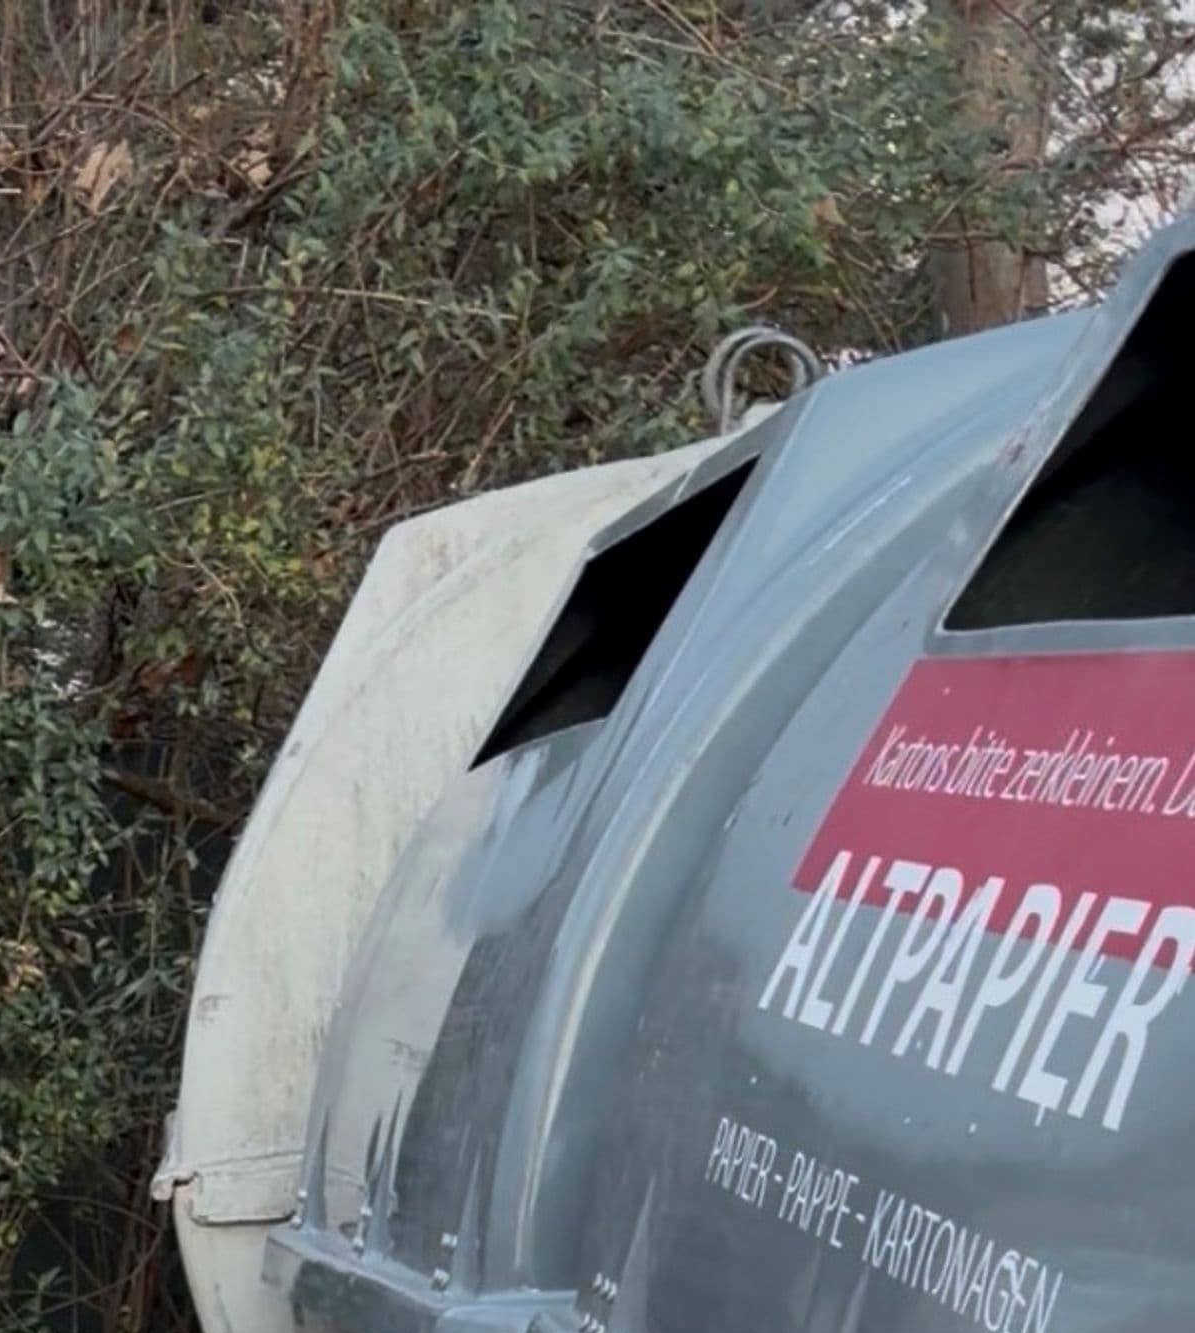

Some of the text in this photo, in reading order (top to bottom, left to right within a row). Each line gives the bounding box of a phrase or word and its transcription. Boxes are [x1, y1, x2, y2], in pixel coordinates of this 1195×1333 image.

[863, 724, 960, 794] Kartons
[944, 725, 1016, 798] bitte
[1000, 727, 1170, 815] zerkleinern.
[758, 850, 1195, 1131] ALTPAPIER
[705, 1117, 777, 1208] PAPIER
[778, 1152, 860, 1249] PAPPE
